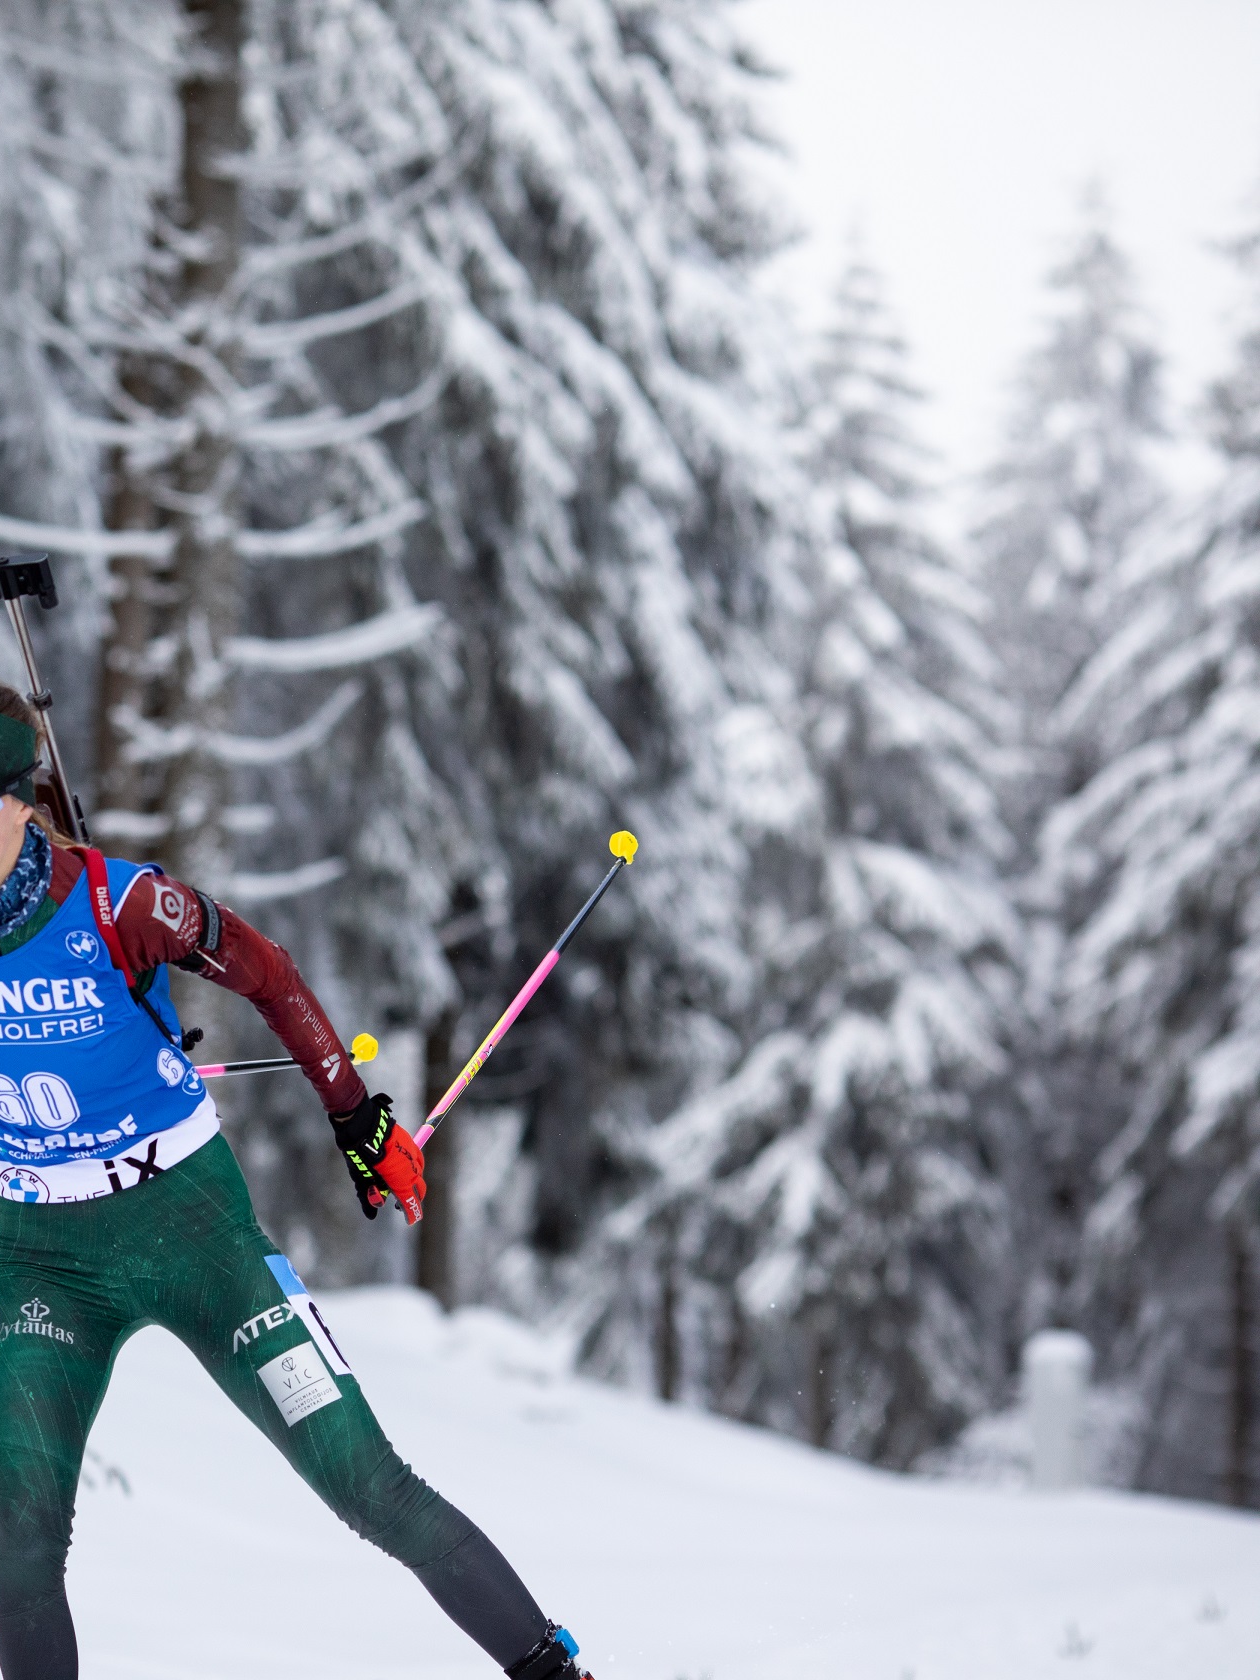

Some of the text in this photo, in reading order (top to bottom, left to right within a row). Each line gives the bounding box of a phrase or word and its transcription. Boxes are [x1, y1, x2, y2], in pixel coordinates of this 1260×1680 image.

[372, 1108, 389, 1150] LEKI
[103, 1138, 165, 1194] iX
[346, 1150, 373, 1178] LEKI
[283, 1368, 312, 1389] VIC
